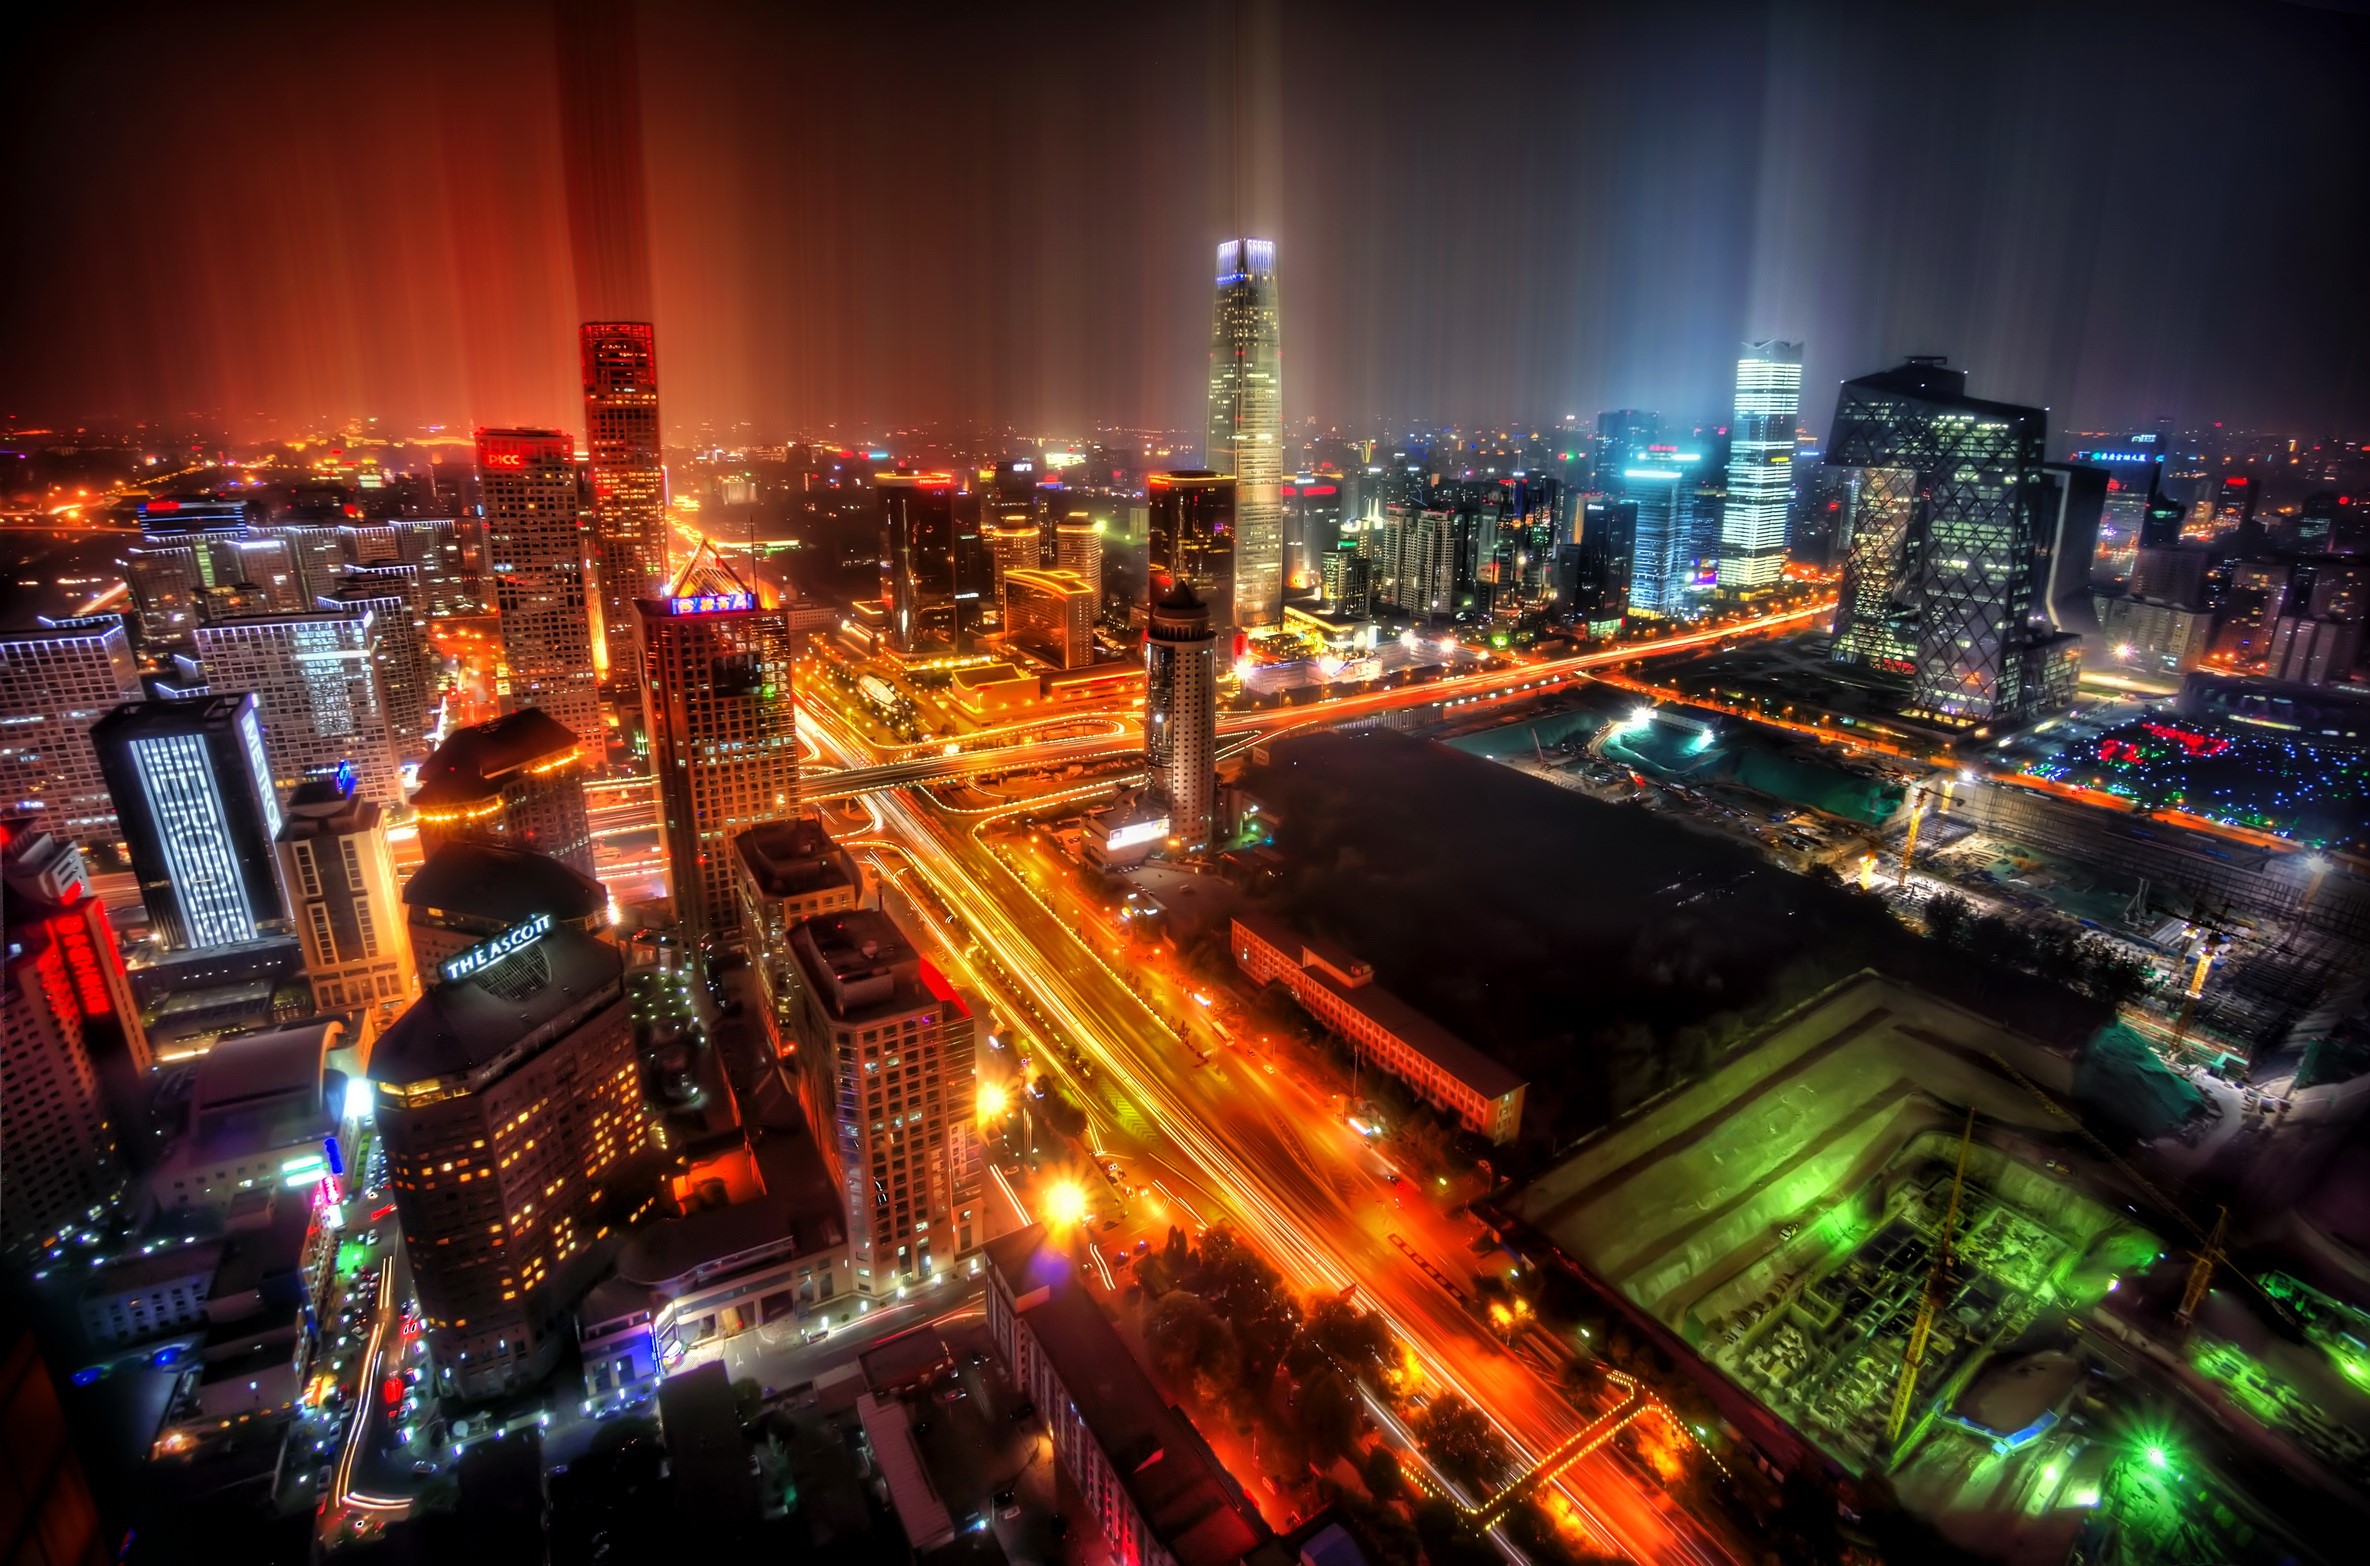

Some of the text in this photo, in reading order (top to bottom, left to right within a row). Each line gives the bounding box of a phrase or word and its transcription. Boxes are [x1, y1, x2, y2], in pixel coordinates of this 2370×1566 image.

[489, 454, 520, 465] PICC
[143, 743, 248, 940] METROPOLIS
[447, 914, 550, 979] THE ASCOTT
